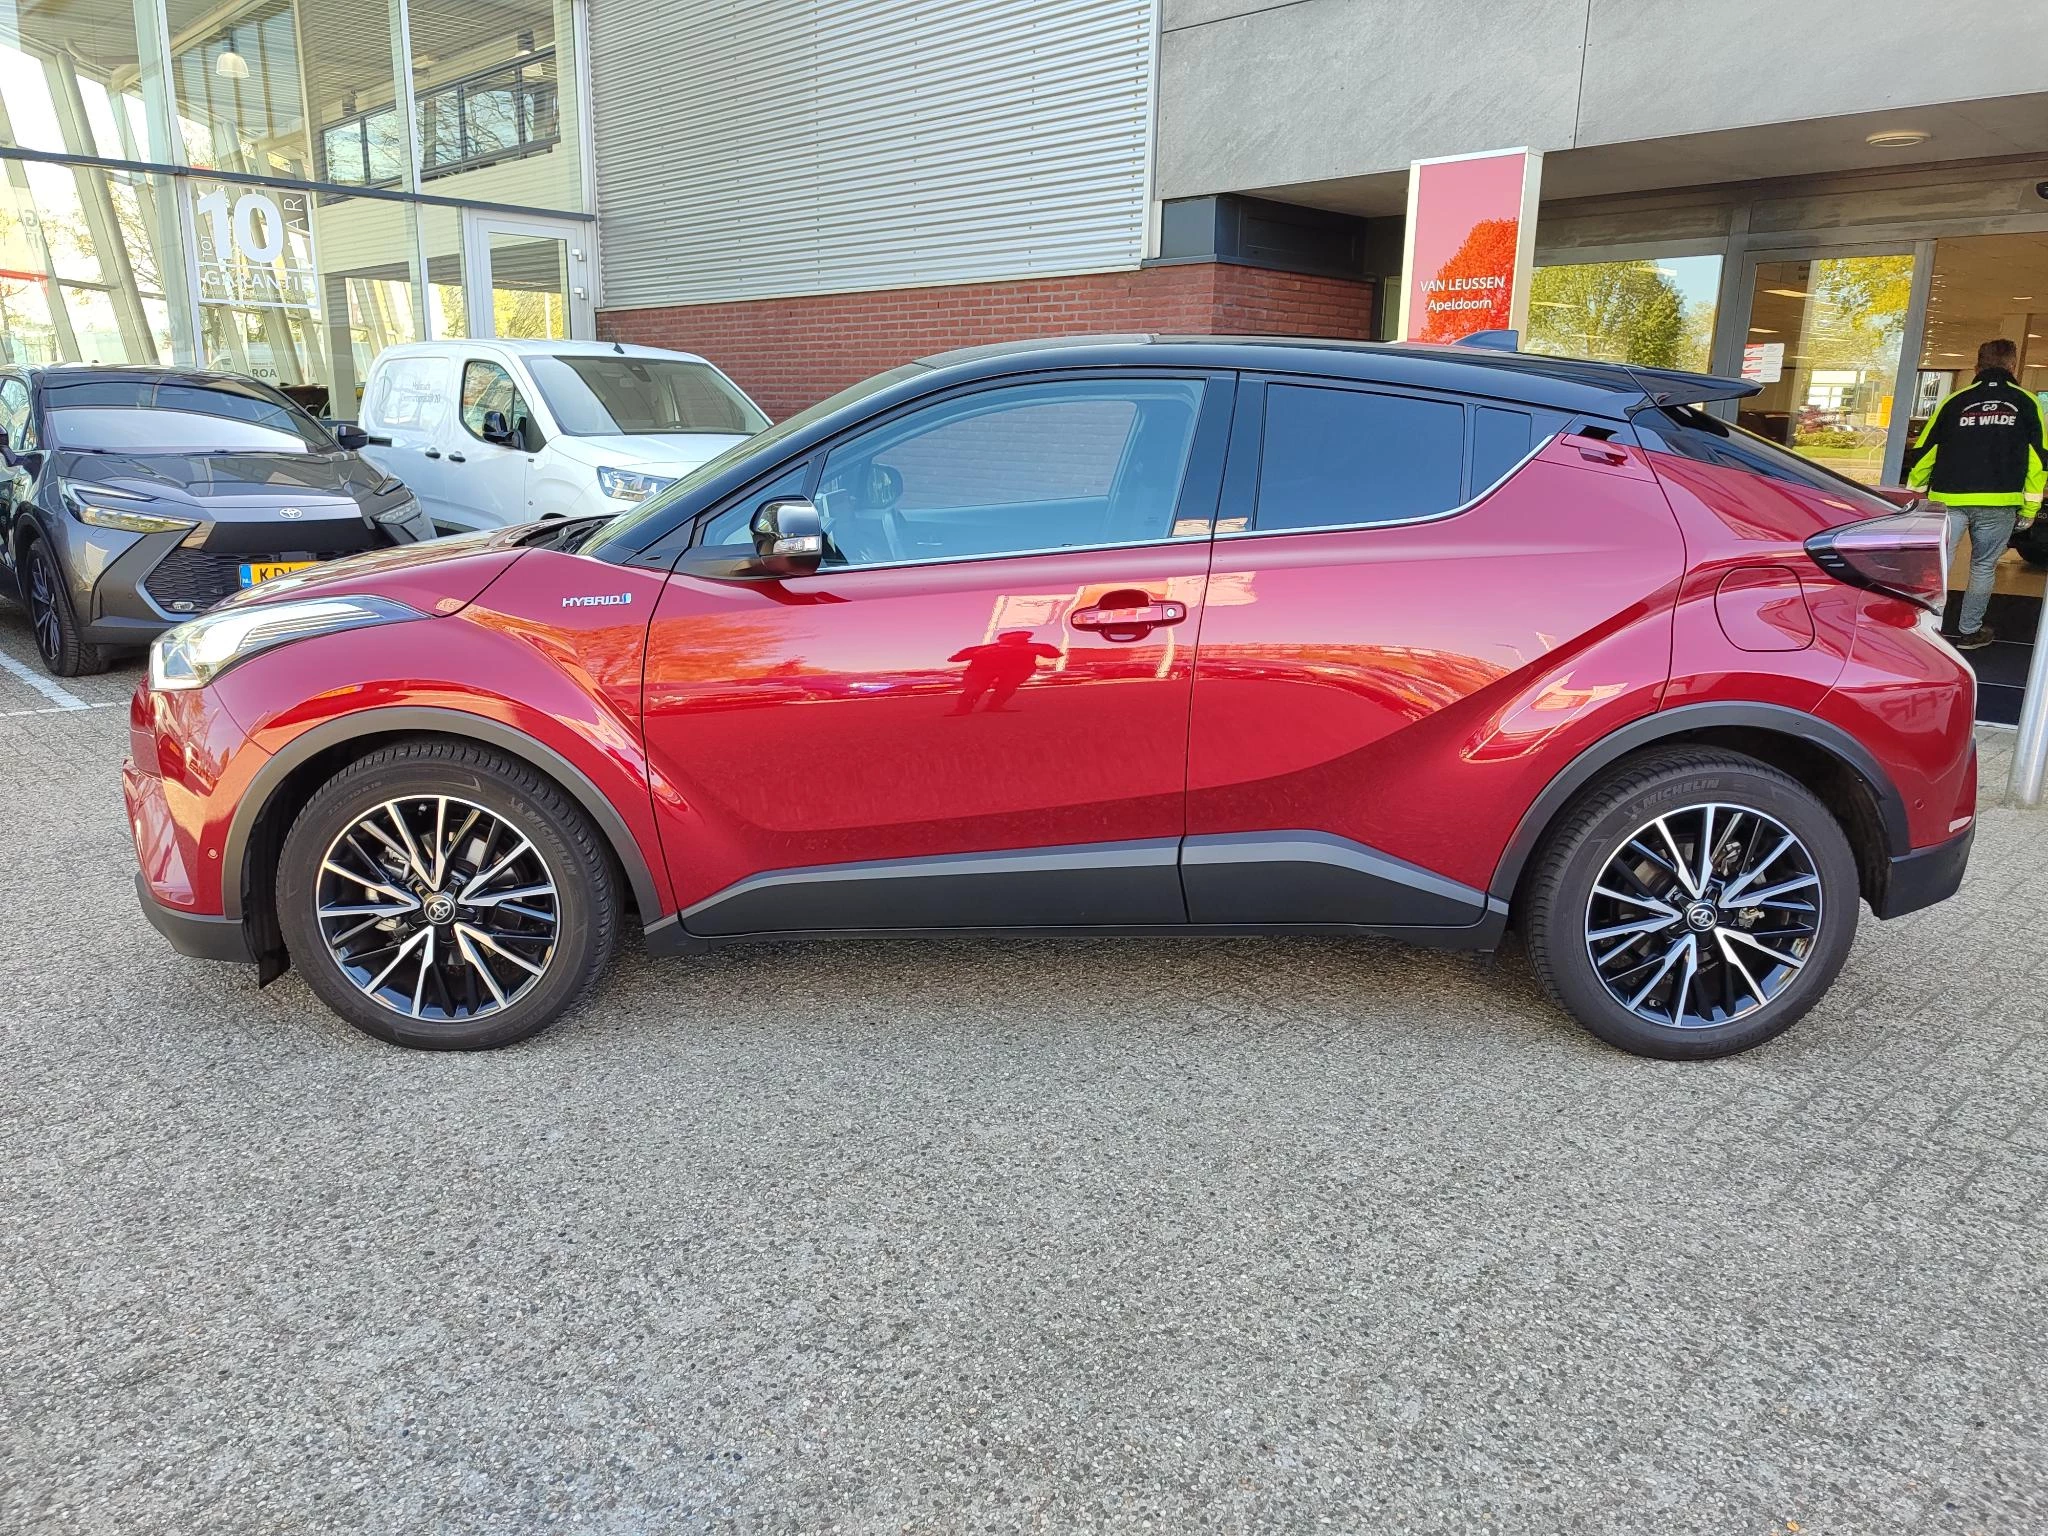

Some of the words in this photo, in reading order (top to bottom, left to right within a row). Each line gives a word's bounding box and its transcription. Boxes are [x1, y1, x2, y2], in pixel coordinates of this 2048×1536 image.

[196, 189, 284, 264] 10
[201, 235, 213, 258] TOT
[1420, 280, 1446, 292] VAN
[1448, 276, 1505, 291] LEUSSEN
[1427, 297, 1492, 313] Apeldoorn
[1960, 416, 1976, 427] DE
[1979, 414, 2017, 426] WILDE
[562, 595, 621, 607] HYBRID
[1643, 777, 1721, 809] MICHELIN
